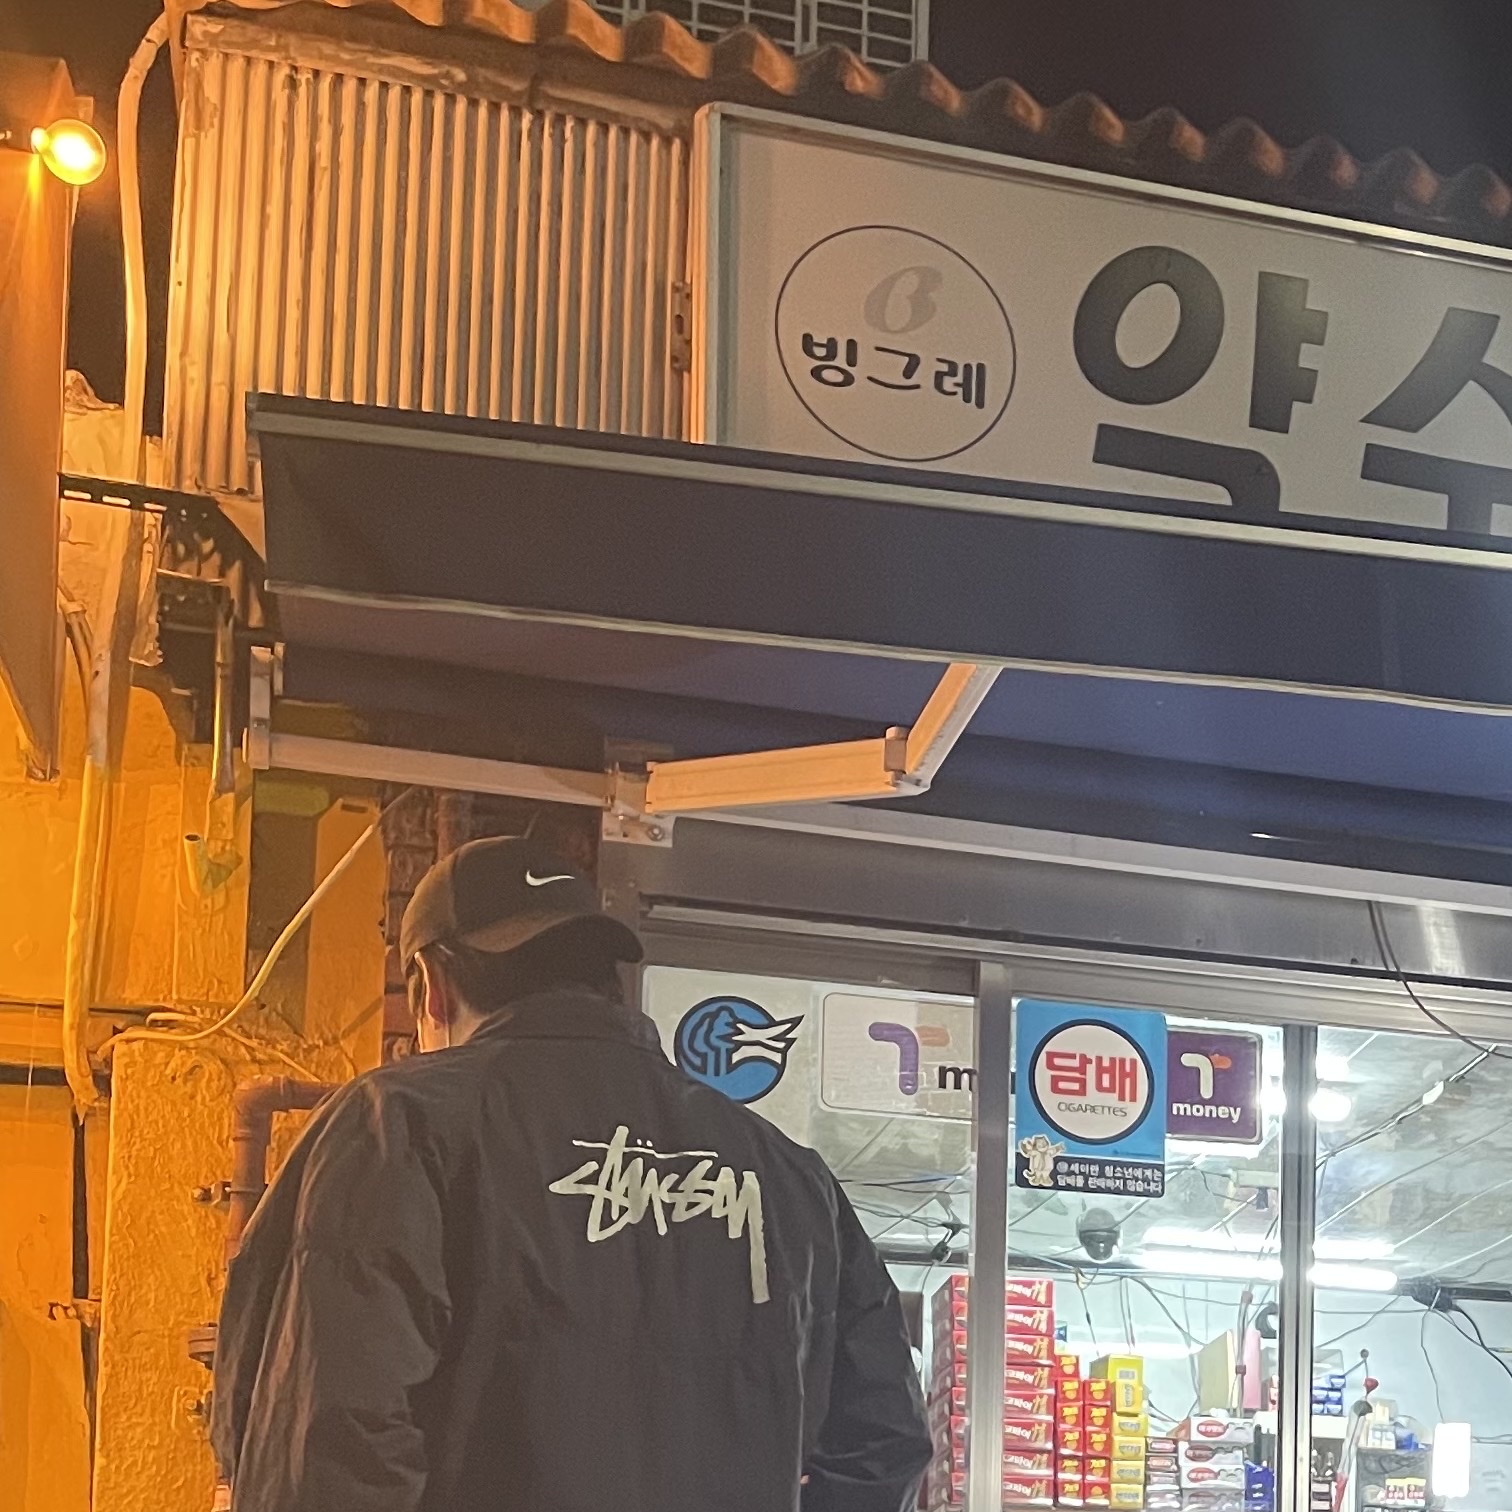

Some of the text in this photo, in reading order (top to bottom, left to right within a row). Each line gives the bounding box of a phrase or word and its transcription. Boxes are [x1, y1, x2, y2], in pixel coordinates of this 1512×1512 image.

[801, 331, 988, 410] 빙그레
[1045, 1051, 1138, 1103] 담배
[1172, 1102, 1241, 1123] money
